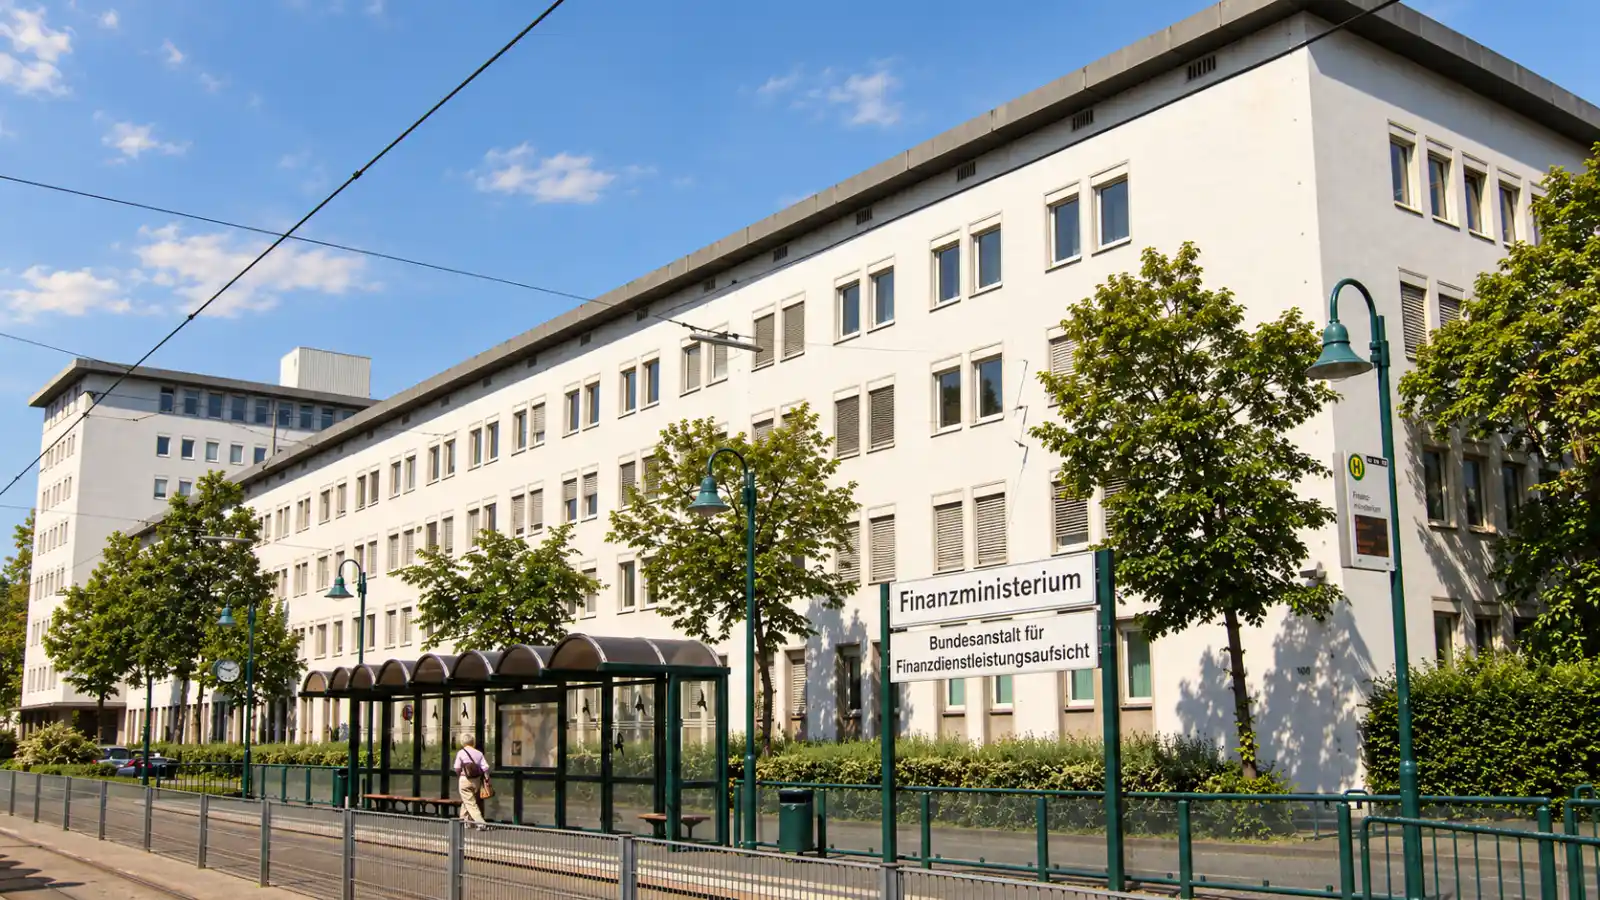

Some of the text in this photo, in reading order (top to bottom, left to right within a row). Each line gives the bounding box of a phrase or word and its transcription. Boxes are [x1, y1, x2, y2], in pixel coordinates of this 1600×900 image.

[1353, 459, 1361, 475] H
[900, 570, 1081, 612] Finanzministerium
[929, 625, 1045, 650] Bundesanstalt für
[896, 643, 1090, 674] Finanzdienstleistungsaufsicht
